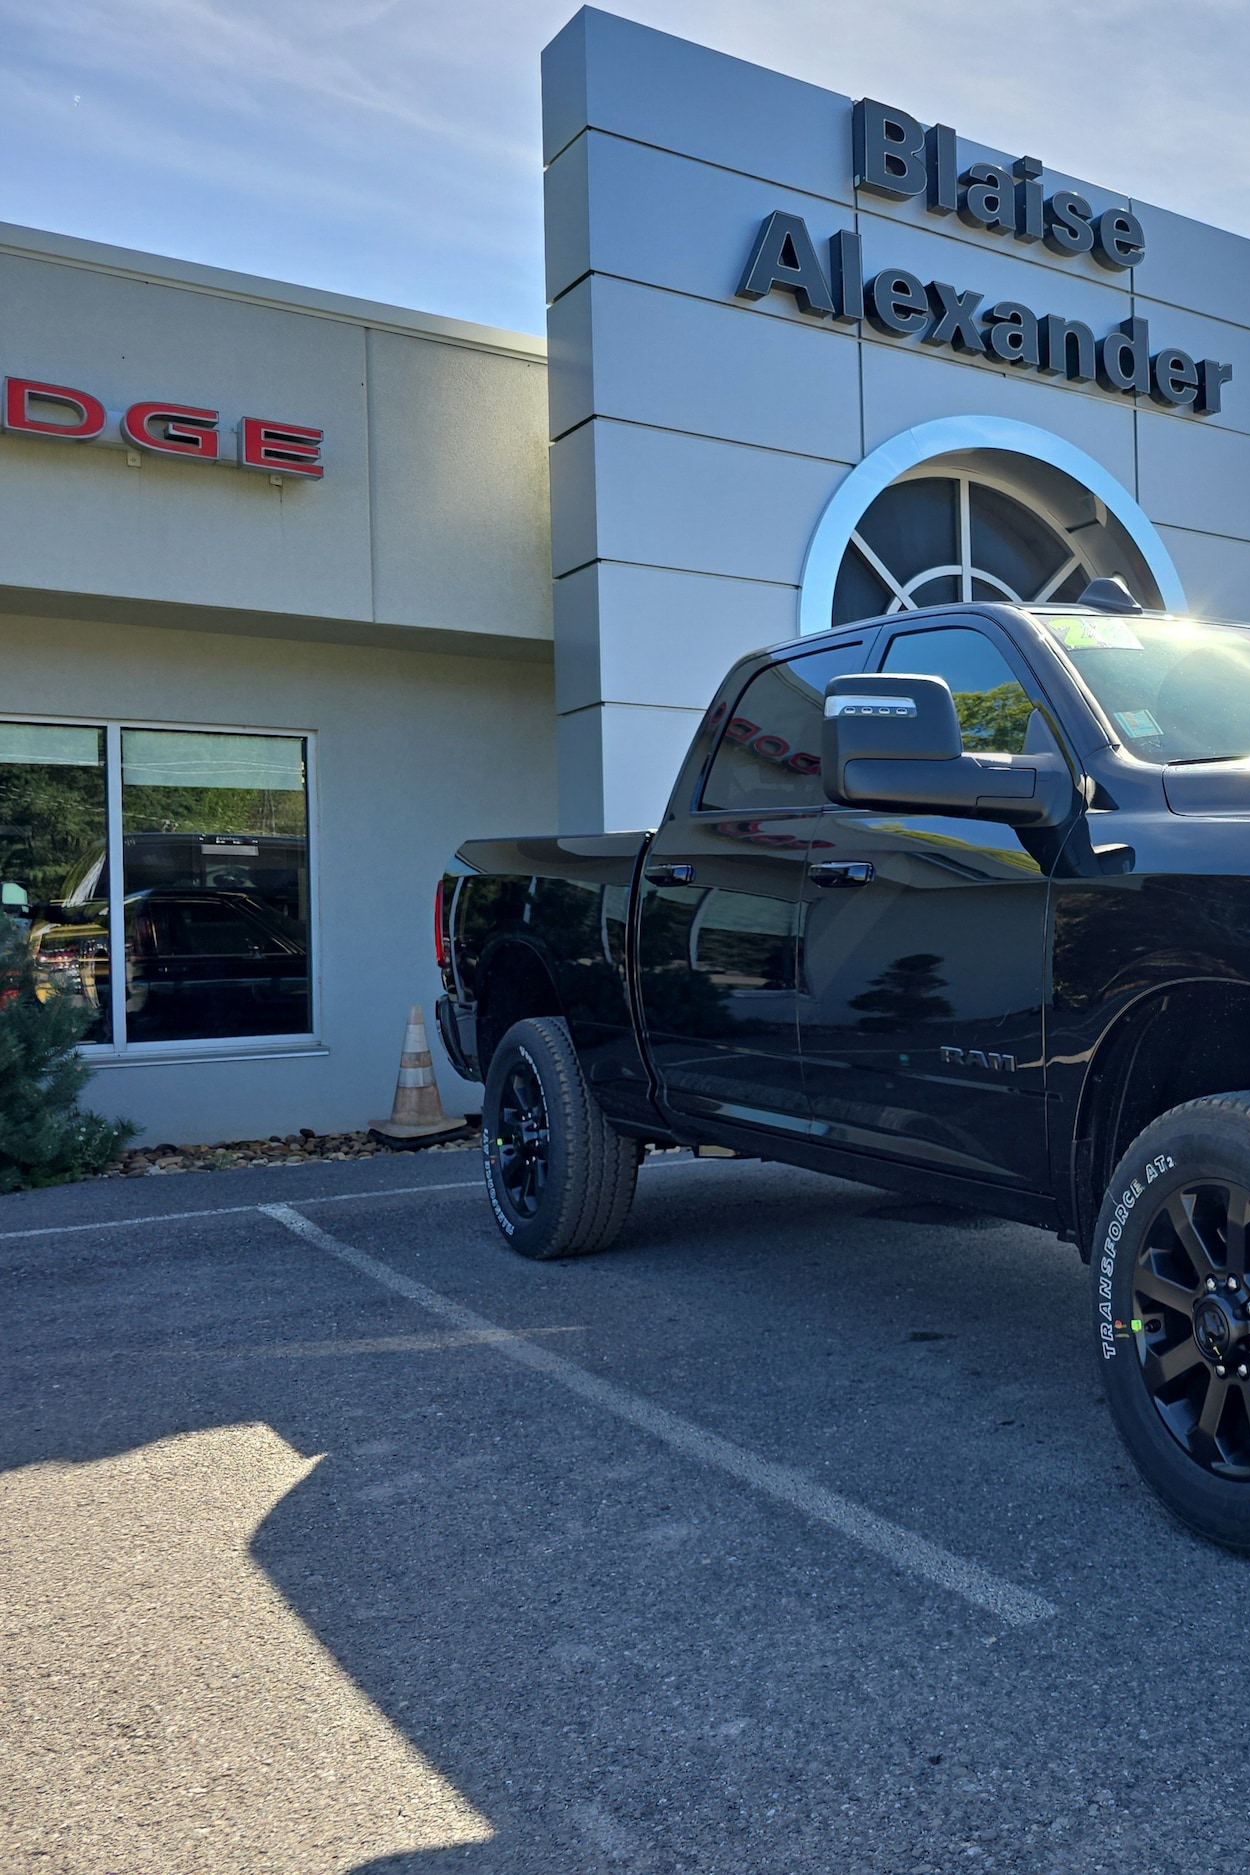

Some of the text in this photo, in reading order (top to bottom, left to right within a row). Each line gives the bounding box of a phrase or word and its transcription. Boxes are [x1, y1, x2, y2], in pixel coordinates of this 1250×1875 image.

[853, 97, 1146, 273] Blaise
[735, 210, 1234, 416] Alexander
[940, 1045, 1018, 1073] RAM
[1099, 1178, 1145, 1360] TRANSFORCE
